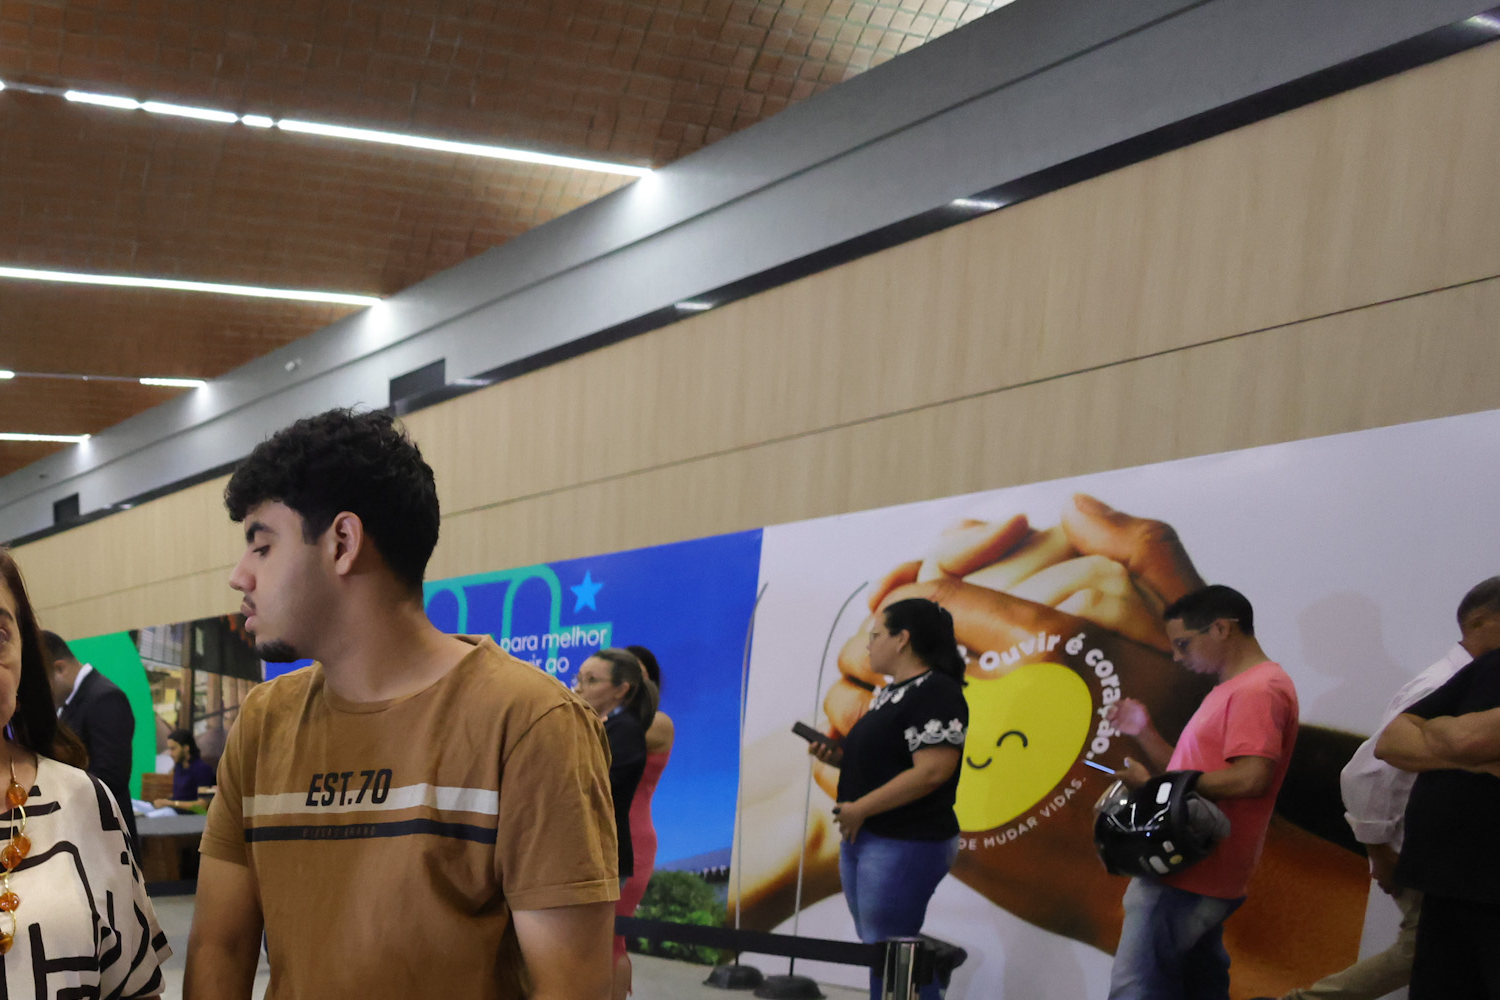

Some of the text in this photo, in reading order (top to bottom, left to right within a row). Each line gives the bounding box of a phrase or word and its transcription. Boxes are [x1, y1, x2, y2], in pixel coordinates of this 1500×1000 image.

[500, 626, 607, 653] para melhor
[979, 632, 1061, 672] Ouvir
[1065, 633, 1086, 656] é
[545, 656, 569, 674] ao
[305, 769, 393, 807] EST.70
[984, 816, 1039, 849] MUDAR
